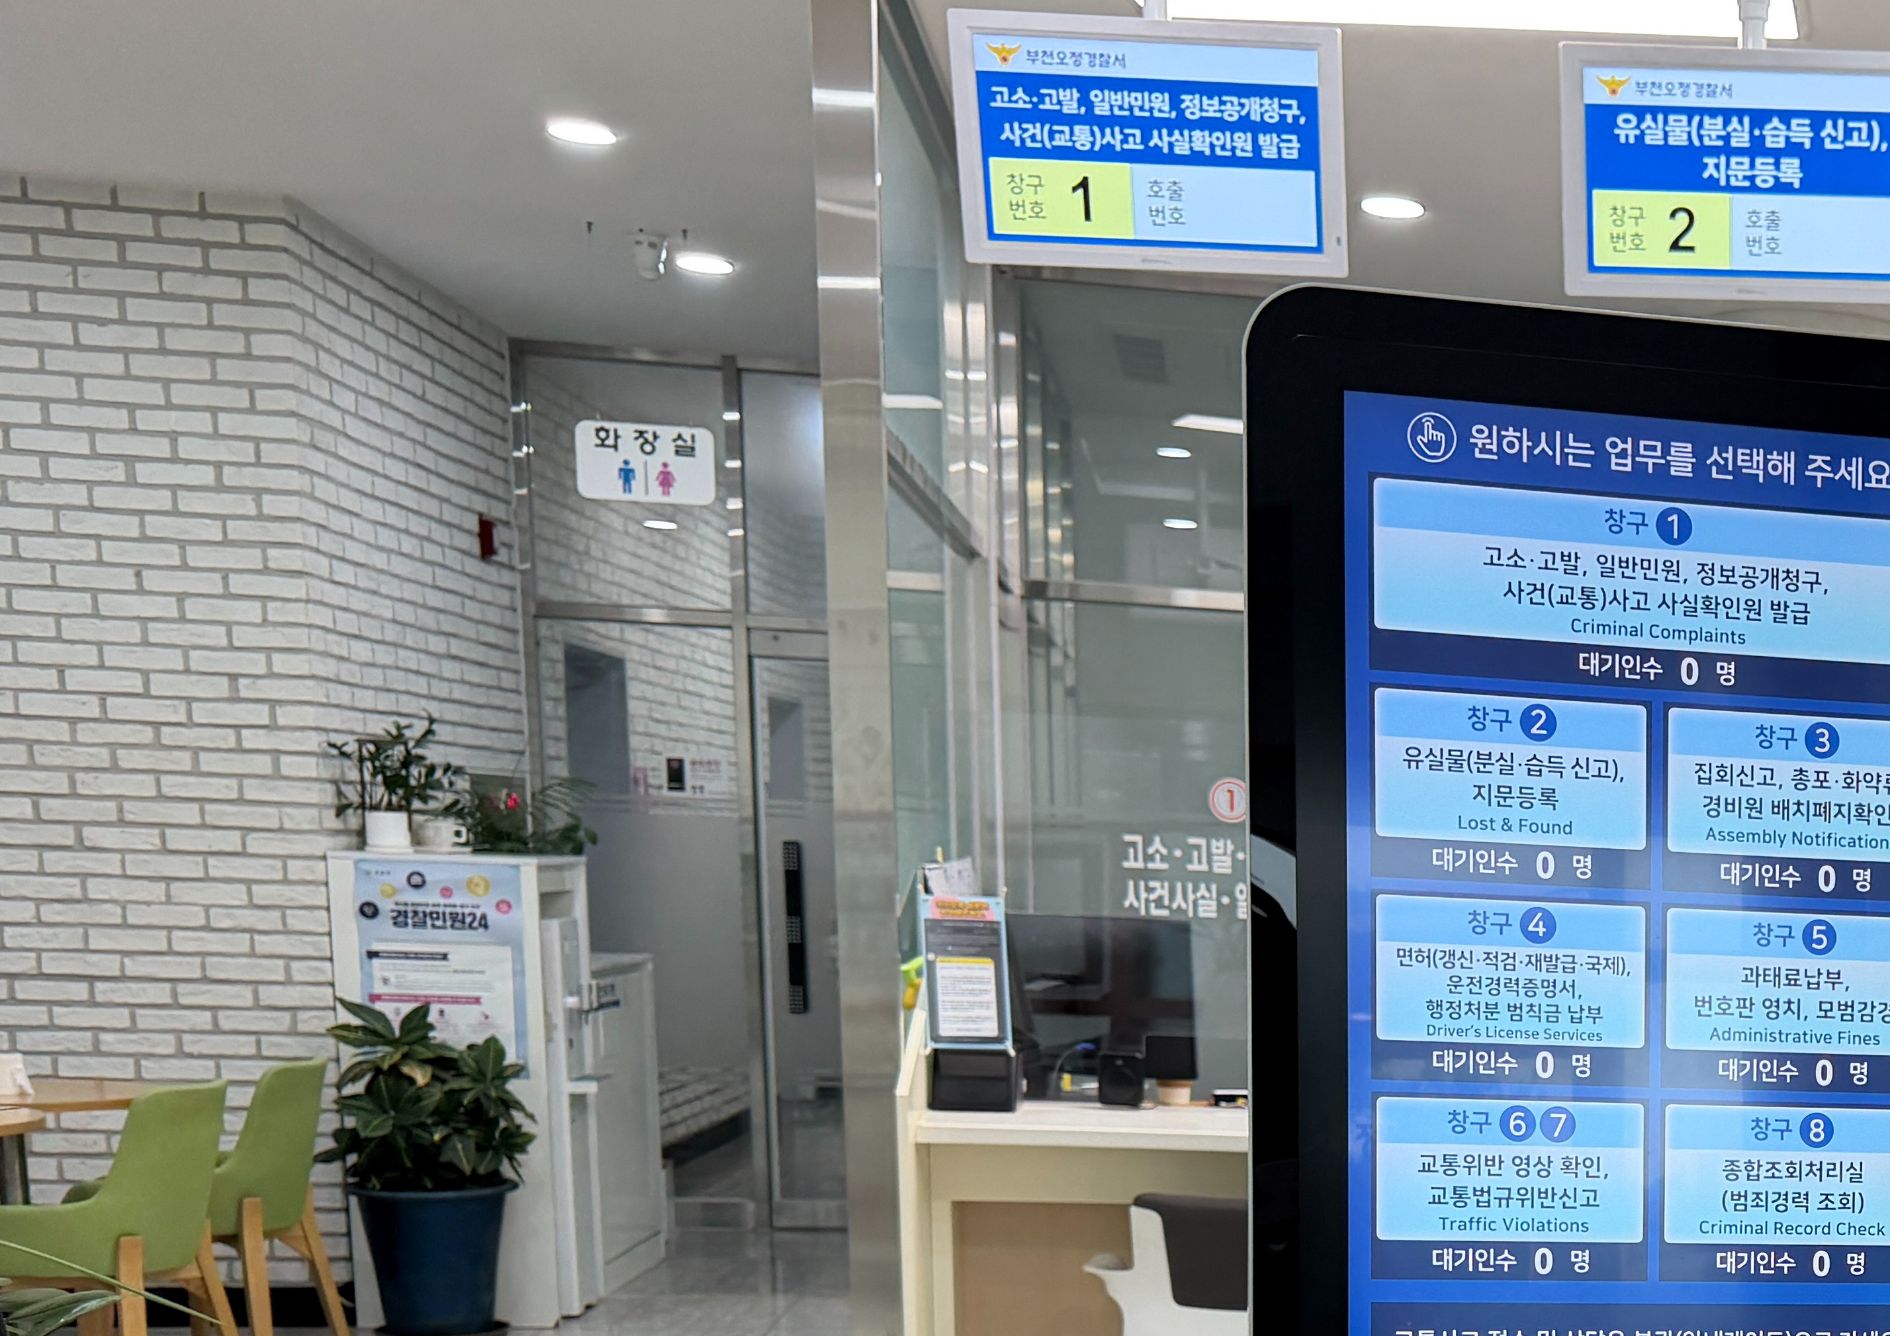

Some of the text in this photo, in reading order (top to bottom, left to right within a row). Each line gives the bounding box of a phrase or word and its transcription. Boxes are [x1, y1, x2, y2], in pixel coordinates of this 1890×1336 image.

[1026, 49, 1126, 69] 부천오정경찰서
[1635, 81, 1733, 98] 부천오정경찰서
[990, 87, 1306, 124] 고소·고발, 일반민원, 정보공개청구,
[1000, 122, 1301, 159] 사건(교통)사고 사실확인원 발급
[1614, 113, 1888, 152] 유실물(분실·습득 신고),
[1007, 174, 1045, 195] 창구
[1702, 156, 1802, 188] 지문등록
[1072, 176, 1092, 222] 1
[1148, 180, 1183, 201] 호출
[1009, 201, 1046, 221] 번호
[1148, 206, 1186, 226] 번호
[1669, 207, 1695, 253] 2
[594, 426, 696, 457] 화장실
[1469, 424, 1595, 468] 원하시는
[1605, 436, 1696, 478] 업무를
[1707, 445, 1795, 486] 선택해
[1604, 508, 1648, 536] 창구
[1483, 546, 1830, 595] 고소·고발, 일반민원, 정보공개청구,
[1503, 580, 1811, 626] 사건(교통)사고 사실확인원 발급
[1571, 617, 1745, 647] Criminal Complaints
[1579, 651, 1736, 687] 대기인수 0 명
[1467, 706, 1512, 732] 창구
[1403, 746, 1625, 783] 유실물(분실·습득 신고),
[1694, 762, 1783, 790] 집회신고,
[1473, 783, 1559, 811] 지문등록
[1703, 795, 1763, 821] 경비원
[1458, 814, 1573, 836] Lost & Found
[1706, 827, 1890, 850] Assembly Notification
[390, 909, 489, 931] 경찰민원24
[1446, 975, 1582, 1001] 운전경력증명서,
[1741, 967, 1850, 993] 과태료납부,
[1426, 1000, 1604, 1024] 행정처분 범칙금 납부
[1694, 994, 1756, 1020] 번호판
[1762, 996, 1809, 1023] 영치,
[1486, 1026, 1538, 1041] License
[1543, 1028, 1603, 1043] Services
[1710, 1027, 1880, 1046] Administrative Fines
[1418, 1154, 1609, 1181] 교통위반 영상 확인,
[1722, 1160, 1864, 1183] 종합조회처리실
[1428, 1186, 1599, 1209] 교통법규위반신고
[1722, 1189, 1865, 1215] (범죄경력 조회)
[1439, 1215, 1589, 1234] Traffic Violations
[1699, 1220, 1885, 1237] Criminal Record Check
